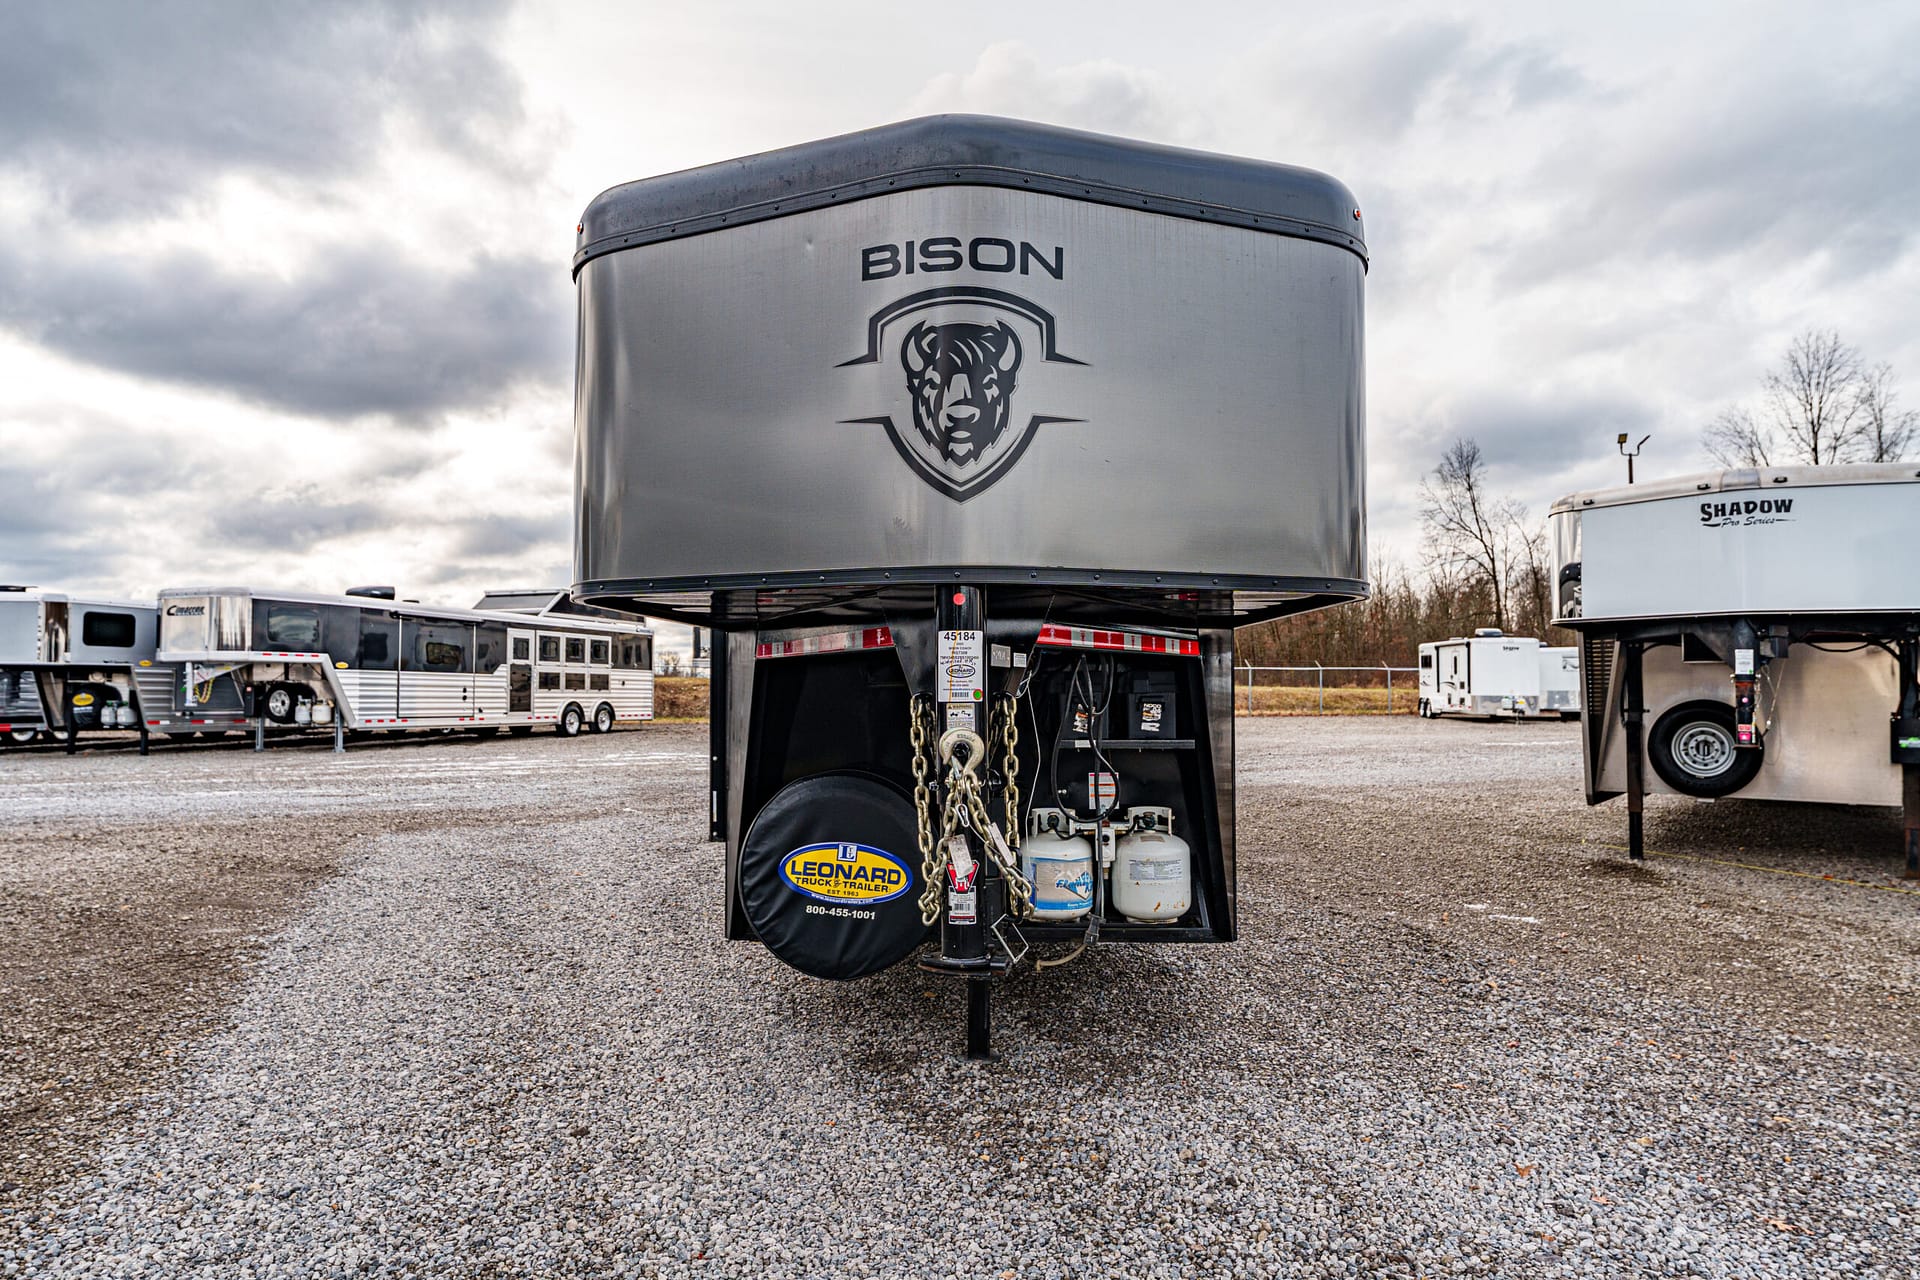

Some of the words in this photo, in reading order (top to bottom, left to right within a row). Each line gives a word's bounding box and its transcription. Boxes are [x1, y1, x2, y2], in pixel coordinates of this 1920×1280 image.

[862, 237, 1063, 281] BISON
[1700, 499, 1793, 521] SHADOW
[1721, 517, 1740, 528] Pro
[1743, 516, 1775, 526] Series
[944, 632, 975, 641] 45184
[791, 860, 901, 885] LEONARD
[795, 876, 832, 887] TRUCK
[843, 881, 889, 893] TRAILER
[805, 905, 876, 920] 800-455-1001
